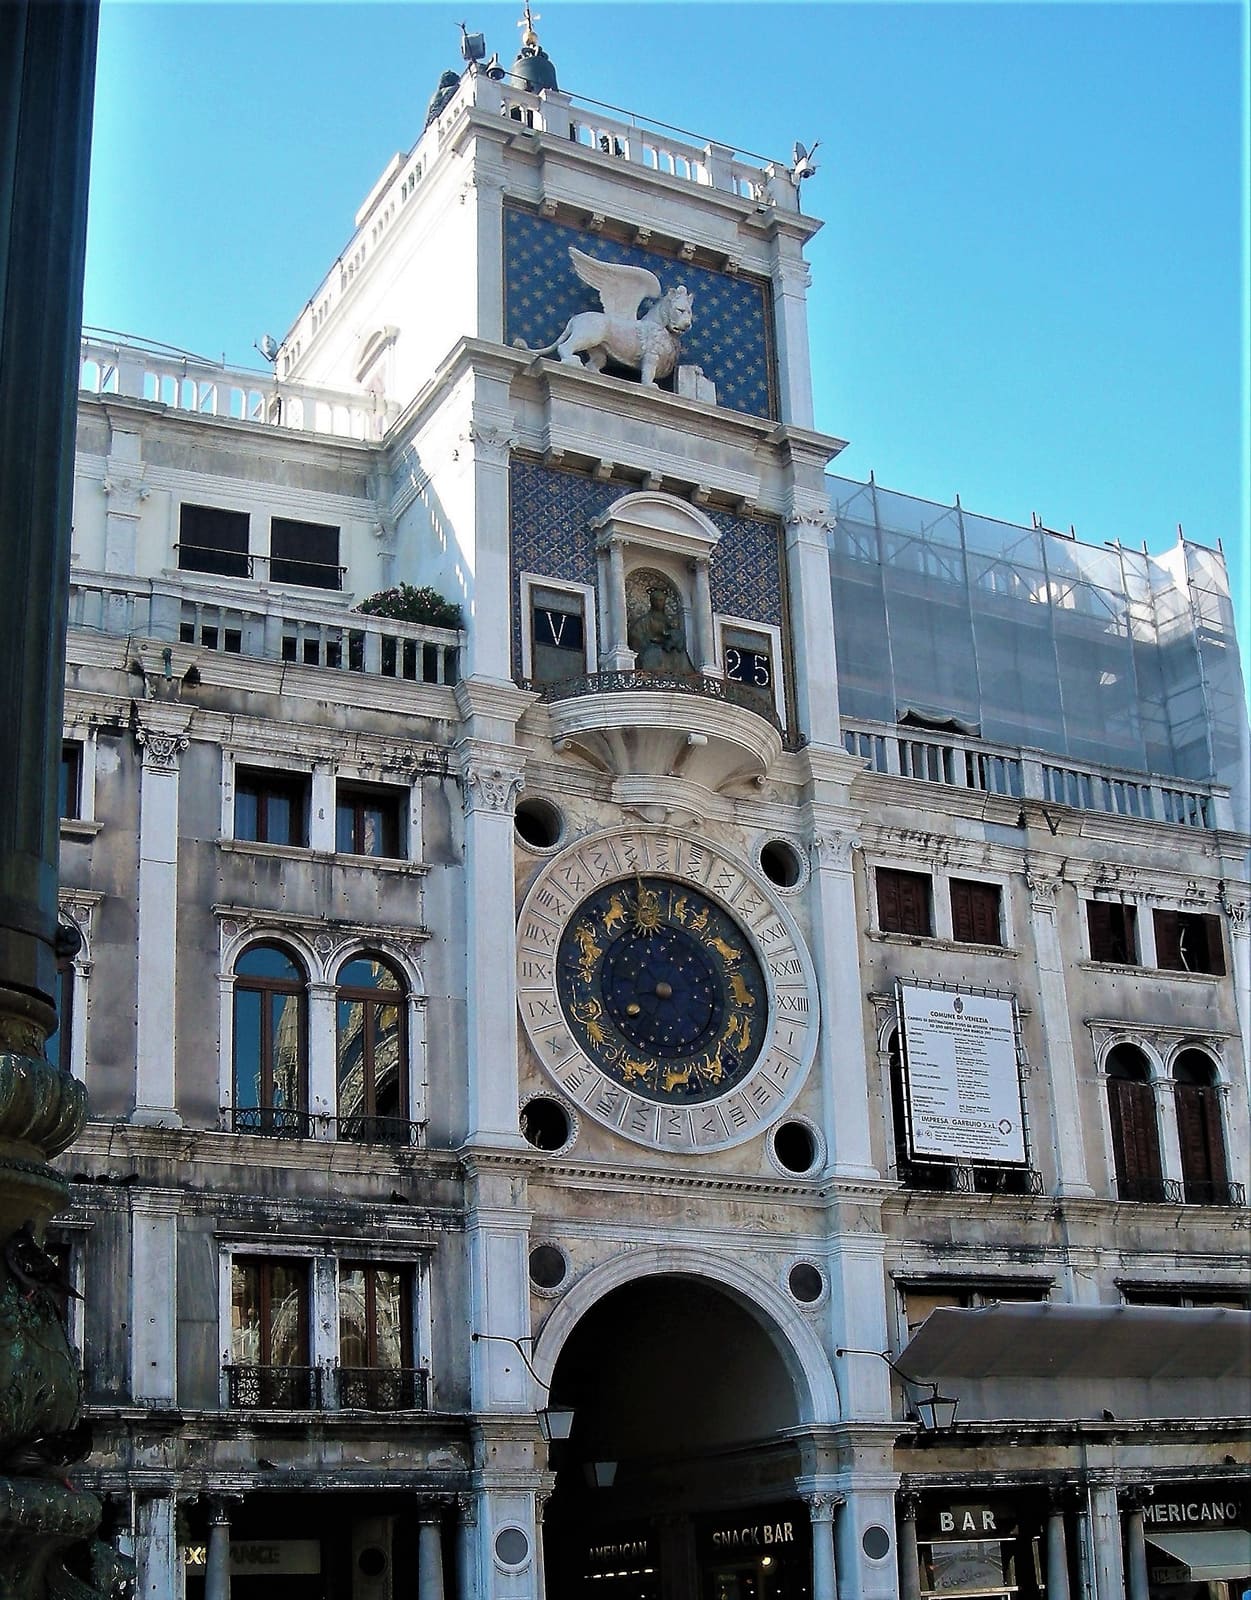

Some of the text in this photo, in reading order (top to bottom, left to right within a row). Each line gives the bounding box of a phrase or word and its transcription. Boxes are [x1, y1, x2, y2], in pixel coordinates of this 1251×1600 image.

[545, 611, 567, 646] V
[725, 649, 769, 686] 25
[587, 844, 612, 877] XVI
[560, 864, 585, 891] XV
[714, 867, 735, 894] XX
[738, 890, 764, 918] XXI
[757, 922, 787, 946] XXII
[523, 961, 546, 979] XII
[770, 959, 802, 977] XXIII
[930, 1011, 955, 1020] COMUNE
[964, 1015, 989, 1024] VENEZIA
[545, 1036, 561, 1054] X
[774, 1062, 789, 1079] II
[753, 1086, 771, 1105] III
[702, 1119, 716, 1132] V
[729, 1106, 747, 1128] IIII
[921, 1115, 949, 1124] IMPRESA
[939, 1510, 997, 1532] BAR
[1142, 1502, 1237, 1522] MERICANO
[712, 1522, 794, 1549] SNACK BAR
